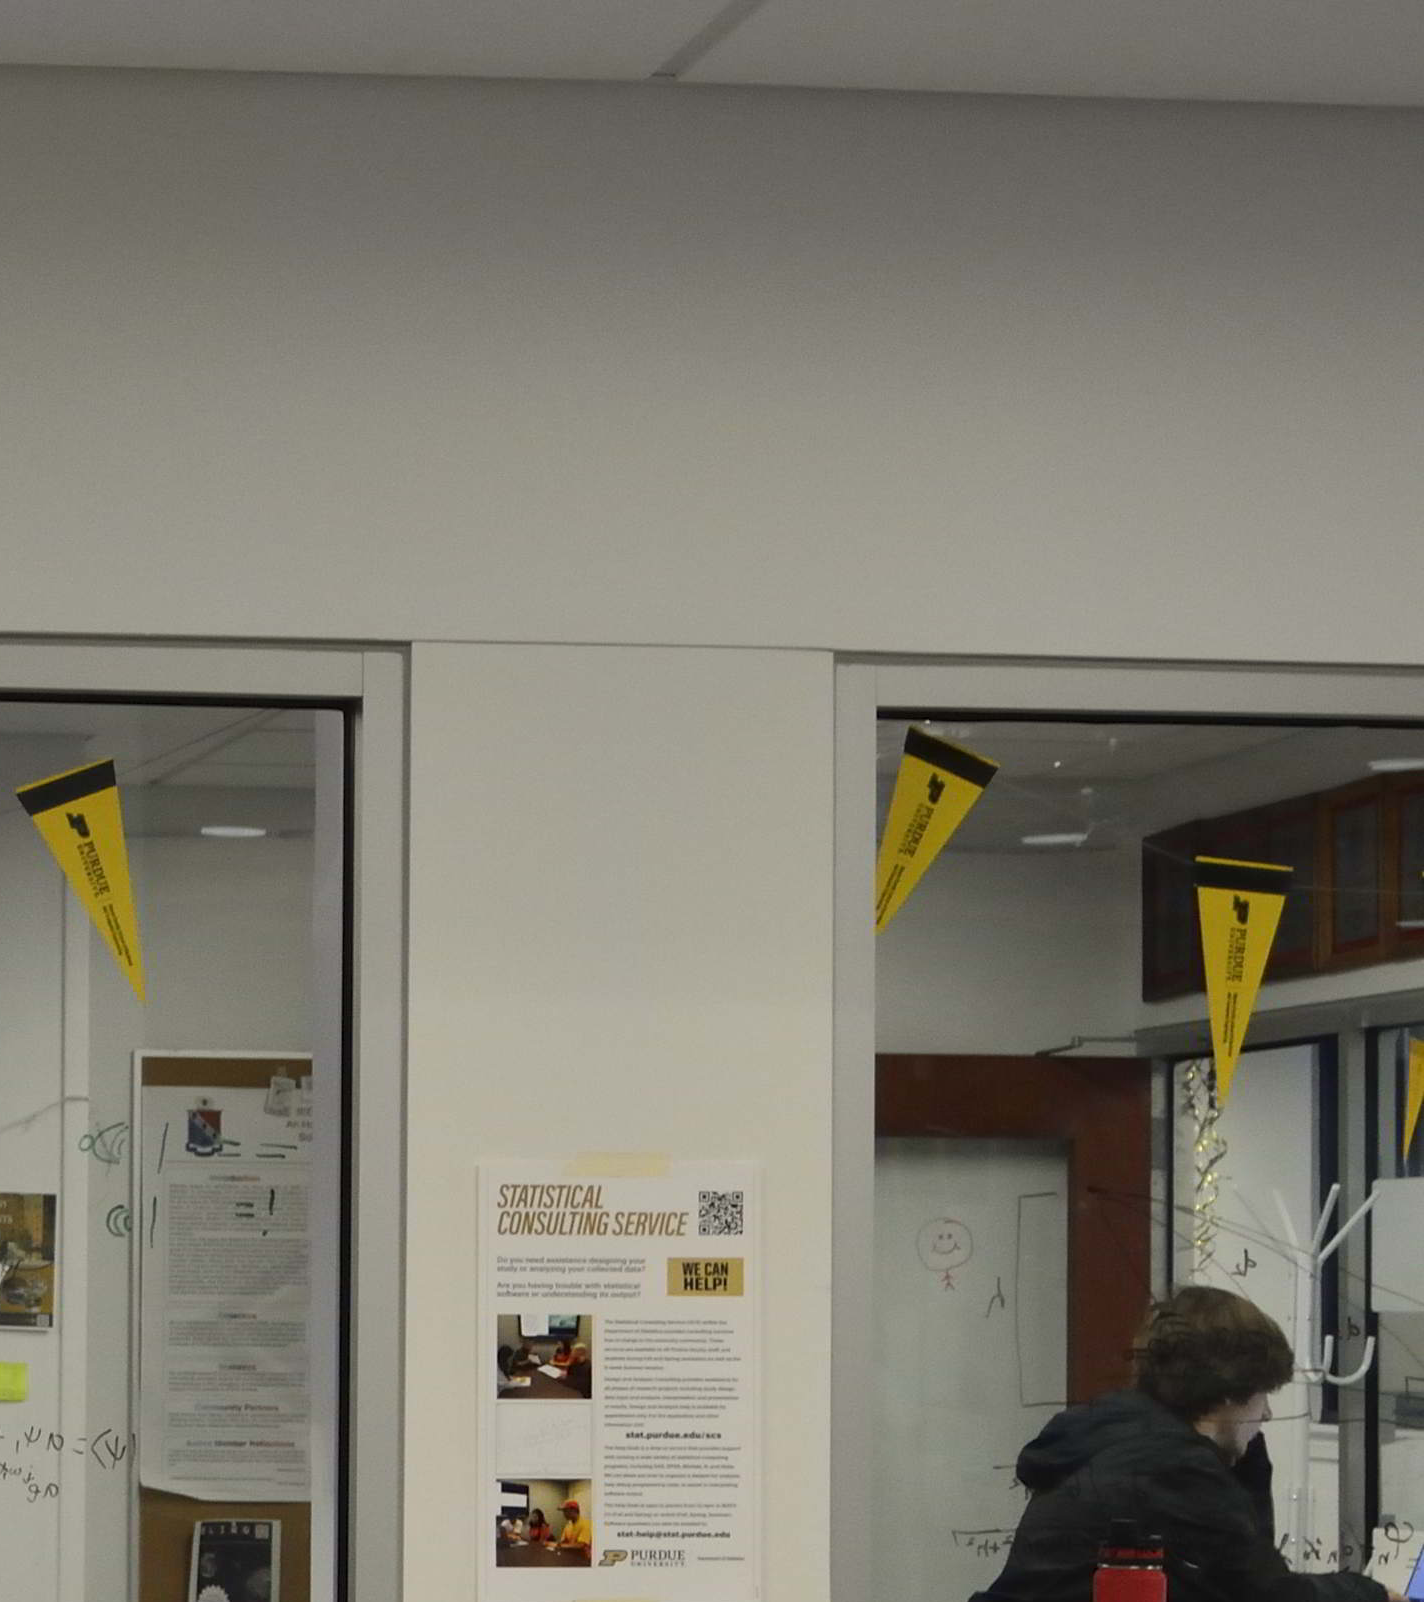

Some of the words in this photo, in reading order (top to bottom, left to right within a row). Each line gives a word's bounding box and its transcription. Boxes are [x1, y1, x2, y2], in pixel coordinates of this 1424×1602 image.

[84, 840, 110, 896] PURDUE
[1232, 928, 1248, 983] PURDUE
[497, 1184, 604, 1209] STATISTICAL
[497, 1211, 610, 1236] CONSULTING
[612, 1212, 690, 1237] SERVICE
[682, 1262, 701, 1277] WE
[704, 1262, 729, 1277] CAN
[683, 1277, 728, 1291] HELP!
[625, 1431, 722, 1440] stat.purdue.edu/scs
[616, 1530, 731, 1540] stat-help@stat.purdue.edu
[630, 1549, 686, 1561] PURDUE
